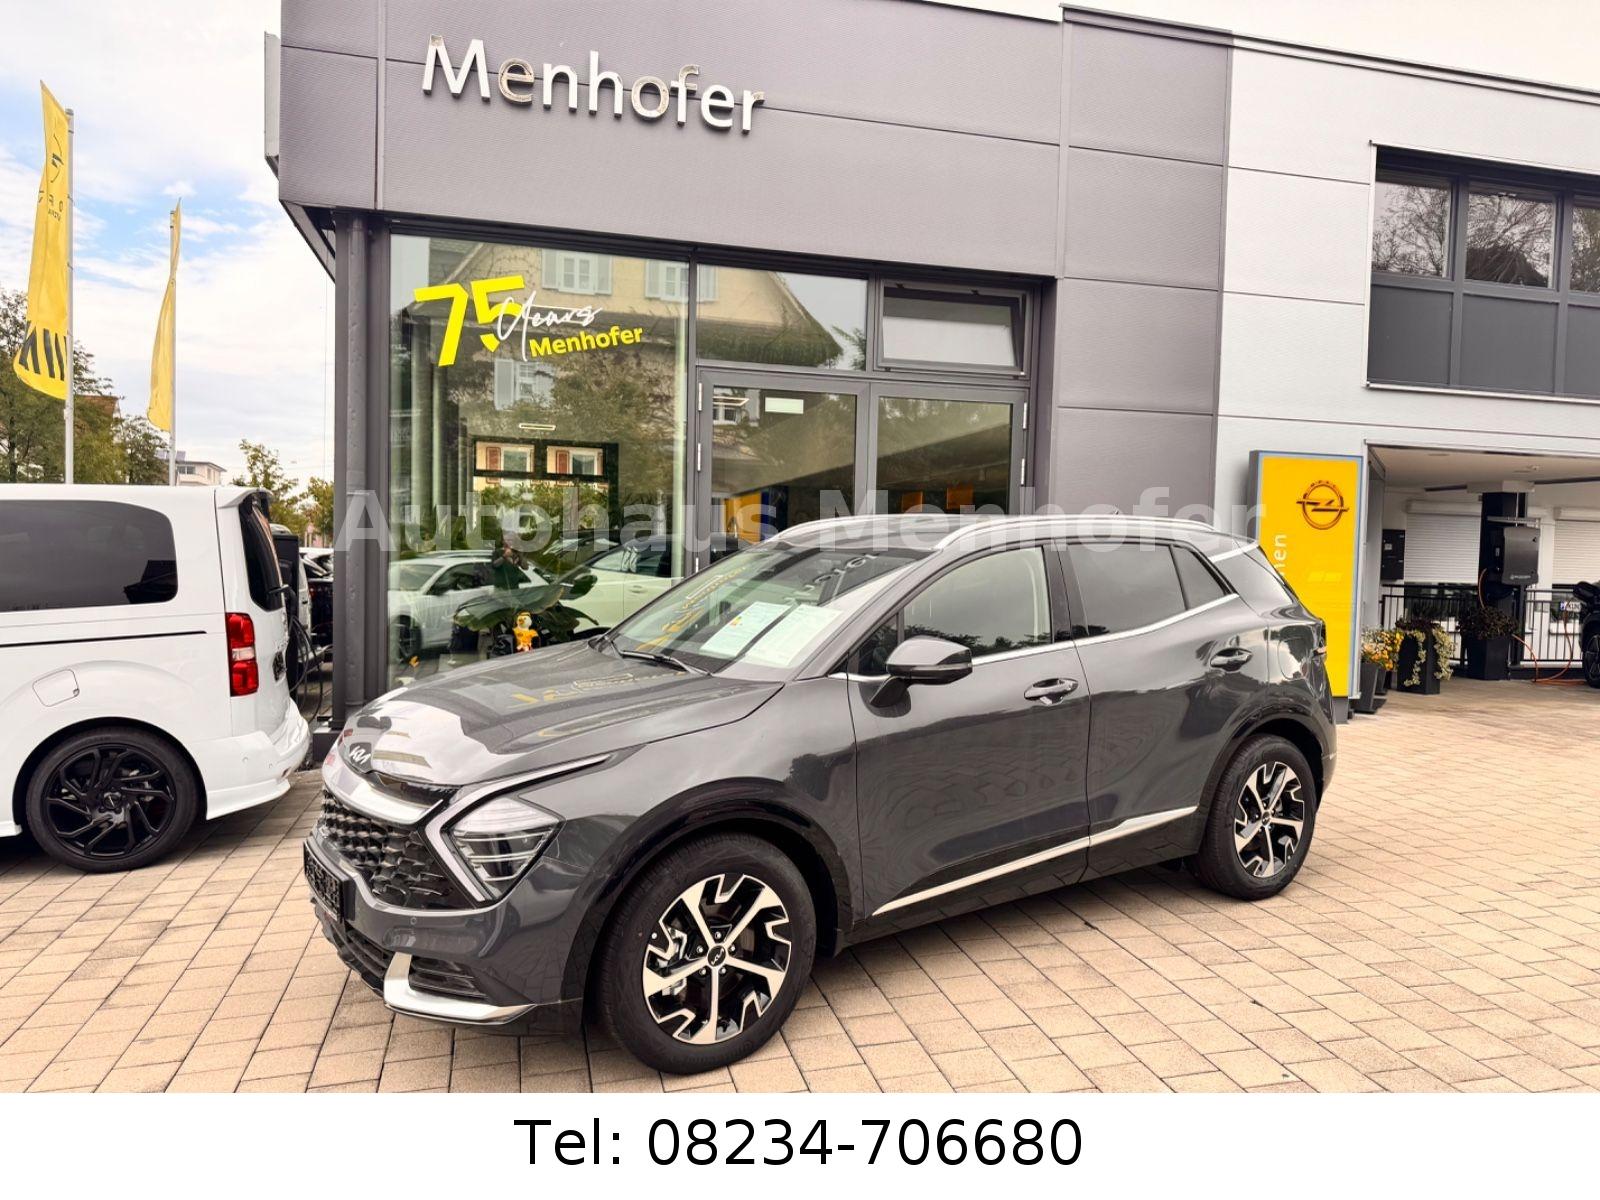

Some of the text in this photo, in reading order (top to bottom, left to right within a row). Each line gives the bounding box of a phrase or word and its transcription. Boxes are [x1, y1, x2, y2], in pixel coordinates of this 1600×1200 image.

[422, 34, 765, 134] Menhofer
[413, 275, 604, 367] 75 Years
[529, 325, 643, 358] Menhofer
